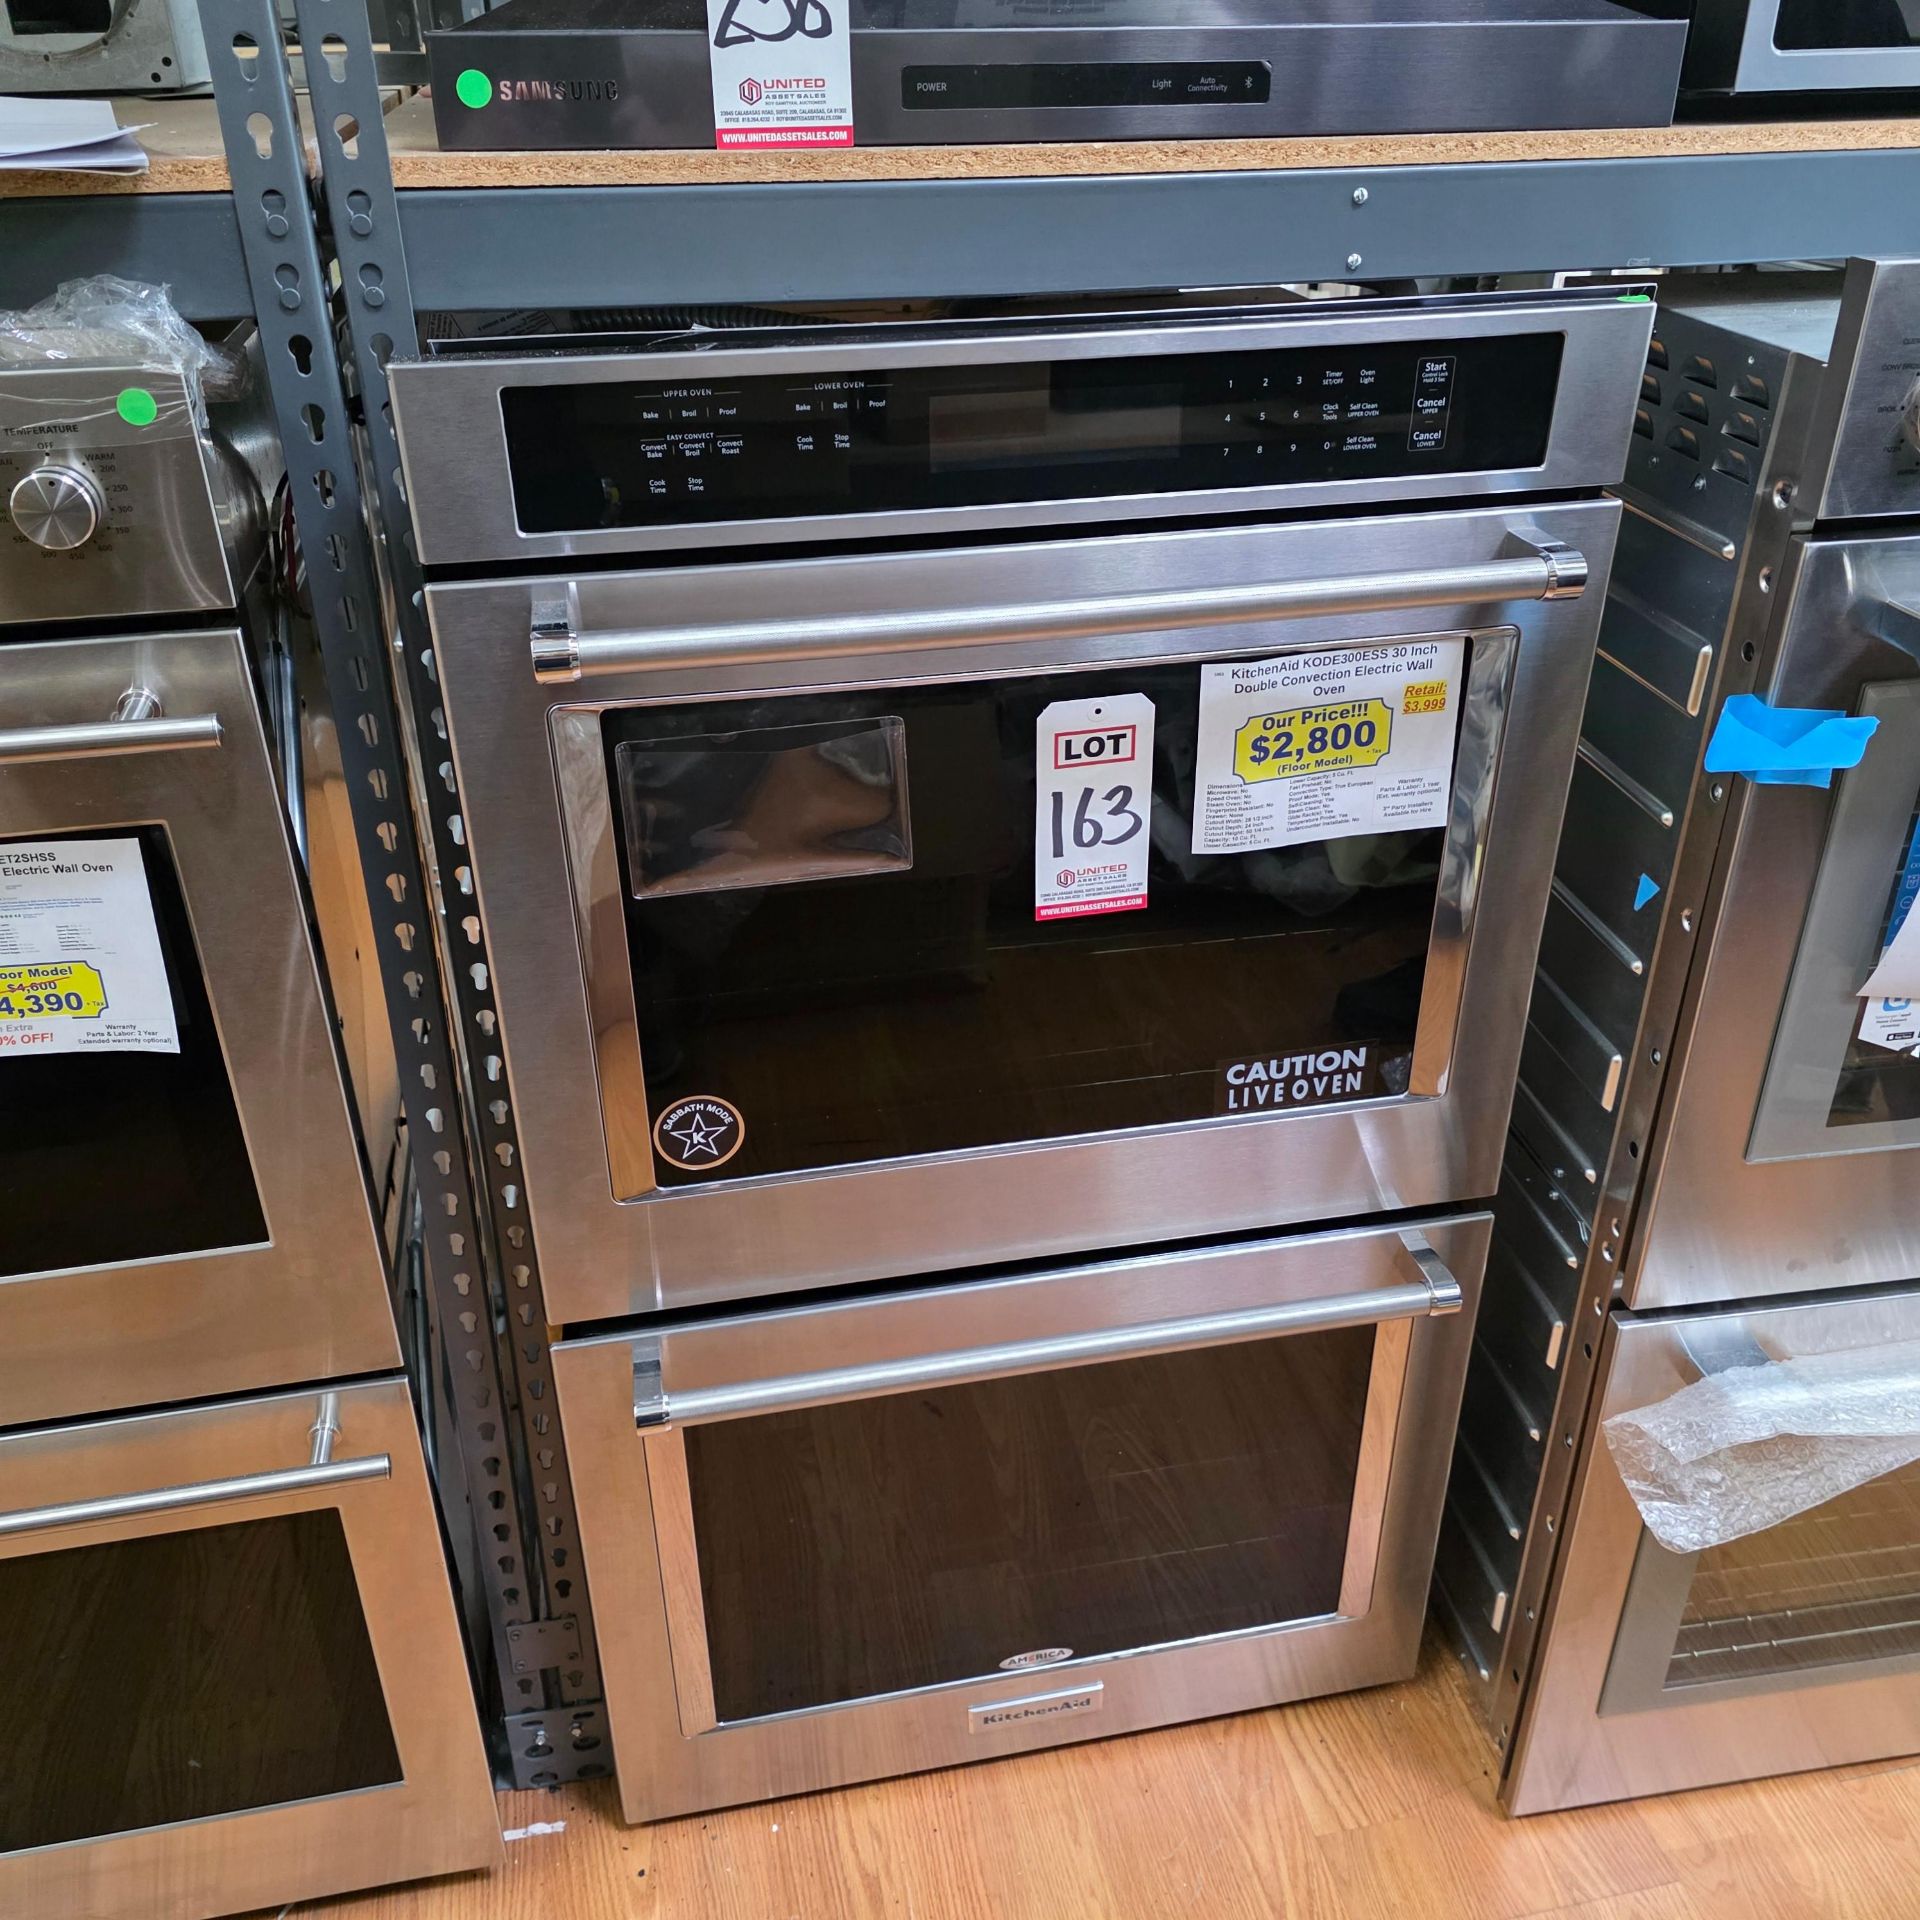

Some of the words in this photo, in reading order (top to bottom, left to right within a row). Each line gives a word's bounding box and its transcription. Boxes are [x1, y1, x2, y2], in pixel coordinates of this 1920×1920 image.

[764, 78, 826, 89] UNITED
[1152, 79, 1172, 90] Light
[1200, 77, 1216, 85] Auto
[499, 80, 619, 101] SAMSUNG
[917, 83, 947, 92] POWER
[1188, 83, 1228, 93] Connectivity
[722, 131, 848, 143] WWW.UNITEDASSETSALES.COM
[1425, 362, 1447, 372] Start
[1325, 370, 1343, 378] Timer
[1360, 369, 1376, 377] Oven
[1262, 378, 1269, 387] 2
[1296, 376, 1302, 385] 3
[1359, 375, 1375, 385] Light
[814, 383, 841, 391] LOWER
[843, 381, 865, 389] OVEN
[663, 390, 688, 398] UPPER
[689, 389, 712, 397] OVEN
[795, 404, 811, 412] Bake
[869, 400, 886, 408] Proof
[1362, 402, 1378, 410] Clean
[1417, 396, 1446, 407] Cancel
[718, 408, 737, 416] Proof
[1322, 403, 1339, 411] Clock
[1224, 414, 1231, 423] 4
[1259, 412, 1266, 421] 5
[1293, 410, 1299, 419] 6
[1322, 413, 1338, 421] Tools
[1364, 409, 1380, 417] OVEN
[4, 424, 79, 437] TEMPERATURE
[1413, 430, 1442, 441] Cancel
[796, 435, 813, 443] Cook
[834, 433, 849, 442] Stop
[1346, 436, 1358, 444] Self
[1358, 435, 1375, 443] Clean
[37, 442, 54, 450] OFF
[679, 442, 705, 450] Convect
[717, 440, 743, 448] Convect
[797, 443, 814, 451] Time
[834, 440, 850, 448] Time
[1223, 448, 1229, 456] 7
[1256, 445, 1263, 454] 8
[1290, 444, 1296, 452] 9
[1323, 441, 1330, 450] 0
[1343, 443, 1361, 451] LOWER
[1361, 442, 1377, 450] OVEN
[1416, 440, 1435, 448] LOWER
[647, 451, 663, 459] Bake
[685, 449, 700, 457] Broil
[721, 447, 740, 455] Roast
[85, 453, 116, 462] WARM
[649, 479, 666, 487] Cook
[688, 477, 703, 485] Stop
[650, 486, 666, 494] Time
[688, 484, 704, 492] Time
[1231, 659, 1300, 680] KitchenAid
[1302, 648, 1388, 670] KODE300ESS
[1392, 646, 1407, 658] 30
[1410, 644, 1438, 656] Inch
[1234, 675, 1278, 695] Double
[1281, 667, 1351, 687] Convection
[1354, 661, 1403, 678] Electric
[1406, 658, 1433, 671] Wall
[1313, 685, 1346, 697] Oven
[1404, 683, 1448, 698] Retail:
[1402, 697, 1447, 714] $3,999
[1262, 715, 1295, 731] Our
[1301, 703, 1369, 725] Price!!!
[1064, 732, 1127, 761] LOT
[1249, 720, 1376, 766] $2,800
[1277, 761, 1311, 776] (Floor
[1314, 755, 1353, 769] Model)
[1051, 784, 1143, 858] 163
[3, 866, 50, 876] Electric
[52, 864, 79, 874] Wall
[82, 863, 114, 873] Oven
[1077, 863, 1128, 876] UNITED
[1040, 897, 1143, 916] WWW.UNITEDASSETSALES.COM
[28, 966, 73, 978] Model
[6, 1024, 33, 1033] Extra
[21, 1033, 54, 1044] OFF!
[1226, 1046, 1367, 1085] CAUTION
[1228, 1082, 1285, 1109] LIVE
[1291, 1071, 1362, 1100] OVEN
[662, 1103, 704, 1131] SABBATH
[706, 1103, 734, 1125] MODE
[692, 1131, 707, 1144] K
[1007, 1649, 1066, 1666] AMERICA
[983, 1697, 1091, 1725] KitchenAid
